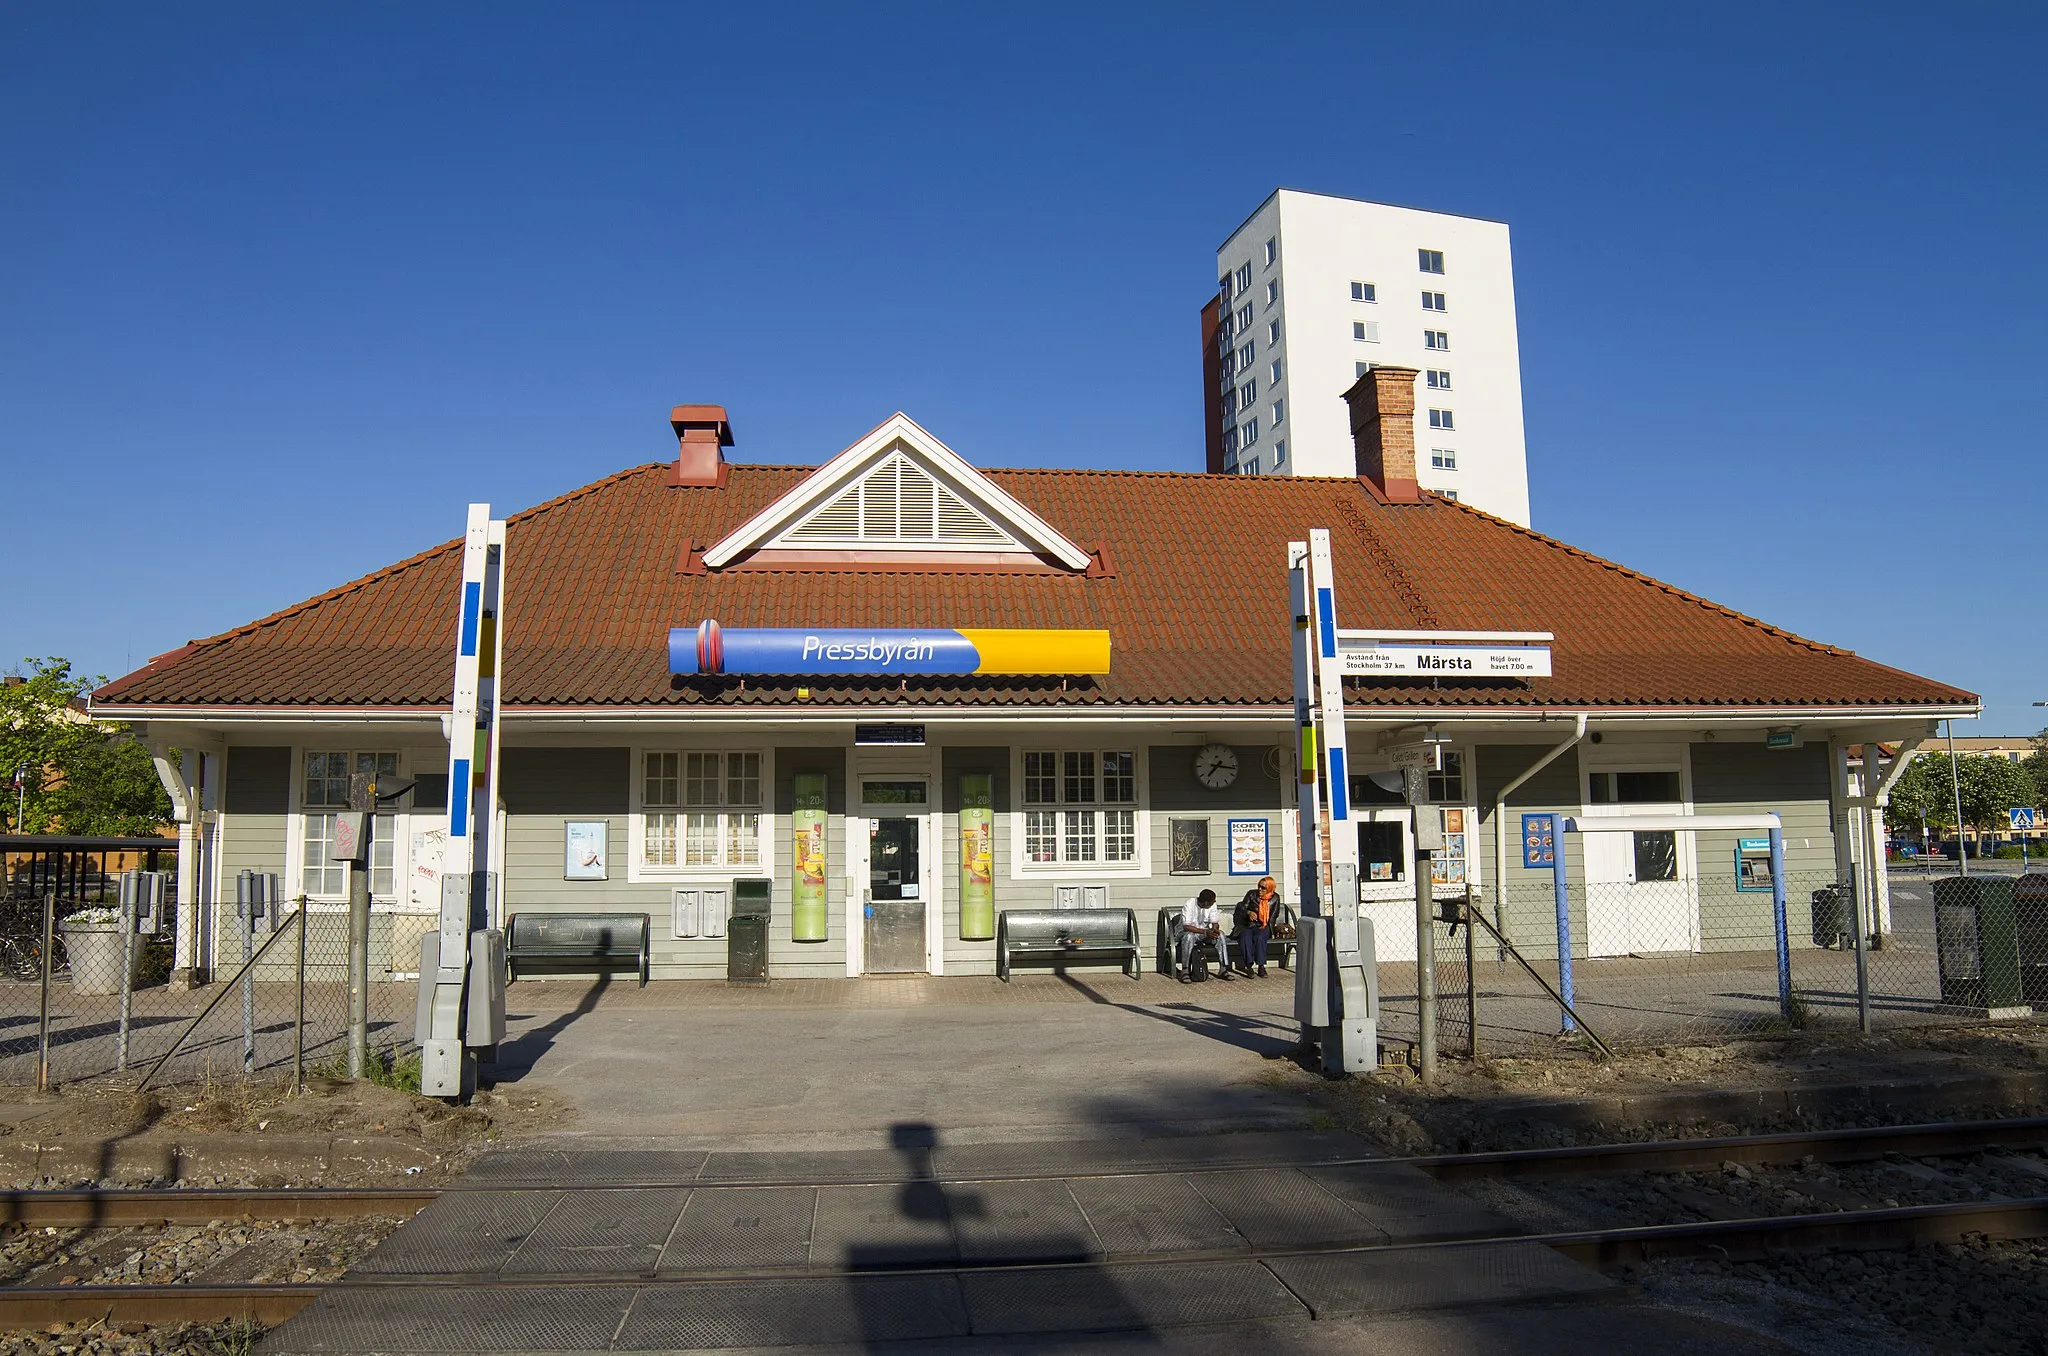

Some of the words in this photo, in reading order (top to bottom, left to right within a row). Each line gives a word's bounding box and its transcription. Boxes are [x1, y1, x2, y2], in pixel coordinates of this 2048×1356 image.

[802, 635, 934, 666] Pressbyrån
[1346, 653, 1374, 661] Avstånd
[1376, 653, 1390, 661] från
[1490, 655, 1506, 663] Höjd
[1346, 661, 1382, 669] Stockholm
[1417, 655, 1472, 669] Märsta
